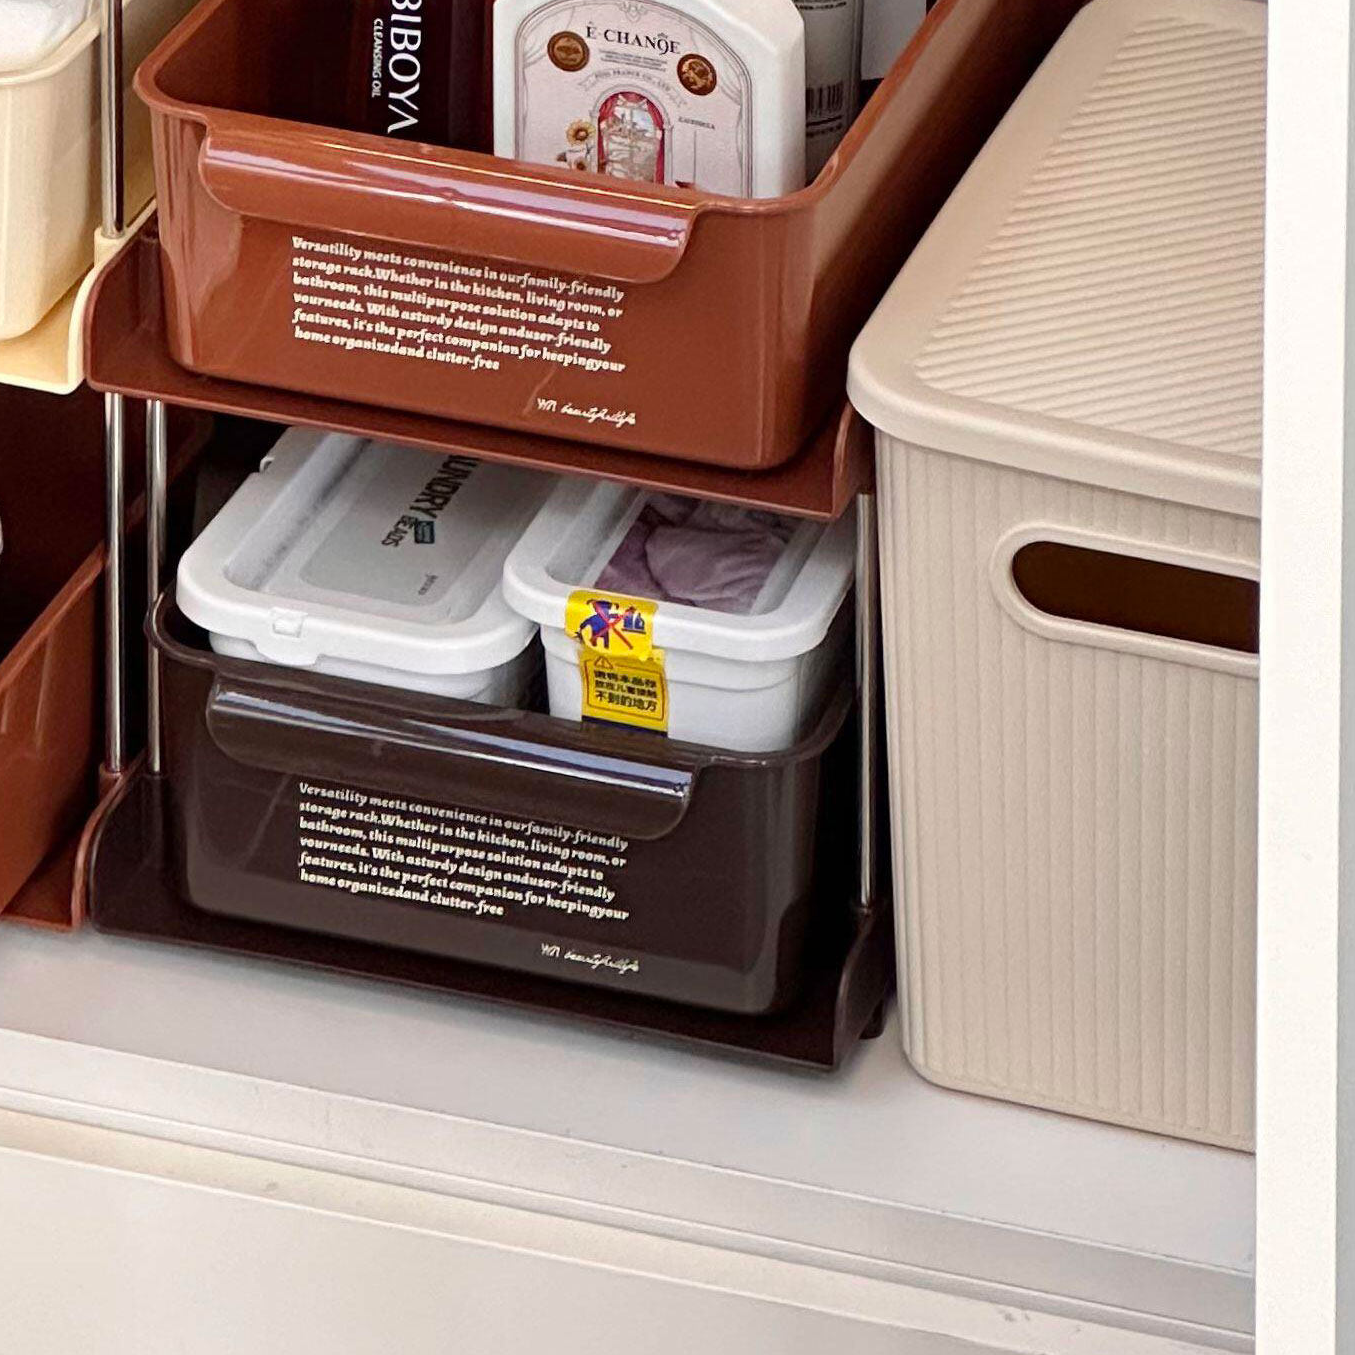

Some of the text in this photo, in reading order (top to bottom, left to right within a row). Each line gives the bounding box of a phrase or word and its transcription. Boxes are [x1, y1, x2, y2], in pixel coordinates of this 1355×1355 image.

[372, 18, 384, 79] CLEANSING
[292, 236, 498, 280] Versatility meets convenience in
[293, 256, 342, 275] storage
[434, 276, 448, 290] in
[450, 279, 471, 294] the
[526, 291, 566, 312] living
[607, 308, 623, 318] or
[364, 283, 389, 298] this
[390, 290, 481, 313] multipurpose
[482, 304, 537, 322] solution
[538, 313, 585, 331] adapts
[586, 320, 600, 332] to
[294, 325, 331, 343] home
[366, 302, 400, 318] With
[454, 315, 498, 336] design
[375, 321, 396, 335] the
[396, 328, 444, 343] perfect
[445, 335, 519, 355] companion
[518, 344, 541, 359] for
[299, 782, 503, 827] Versatility meets convenience in
[299, 802, 348, 820] storage
[439, 823, 453, 836] in
[455, 826, 476, 840] the
[530, 838, 570, 860] living
[611, 857, 627, 867] or
[369, 829, 394, 844] this
[395, 836, 486, 859] multipurpose
[487, 851, 541, 869] solution
[542, 860, 589, 879] adapts
[591, 869, 603, 880] to
[300, 868, 336, 886] home
[372, 847, 405, 863] With
[458, 861, 502, 881] design
[379, 865, 401, 880] the
[401, 872, 448, 892] perfect
[449, 881, 523, 901] companion
[522, 891, 545, 905] for
